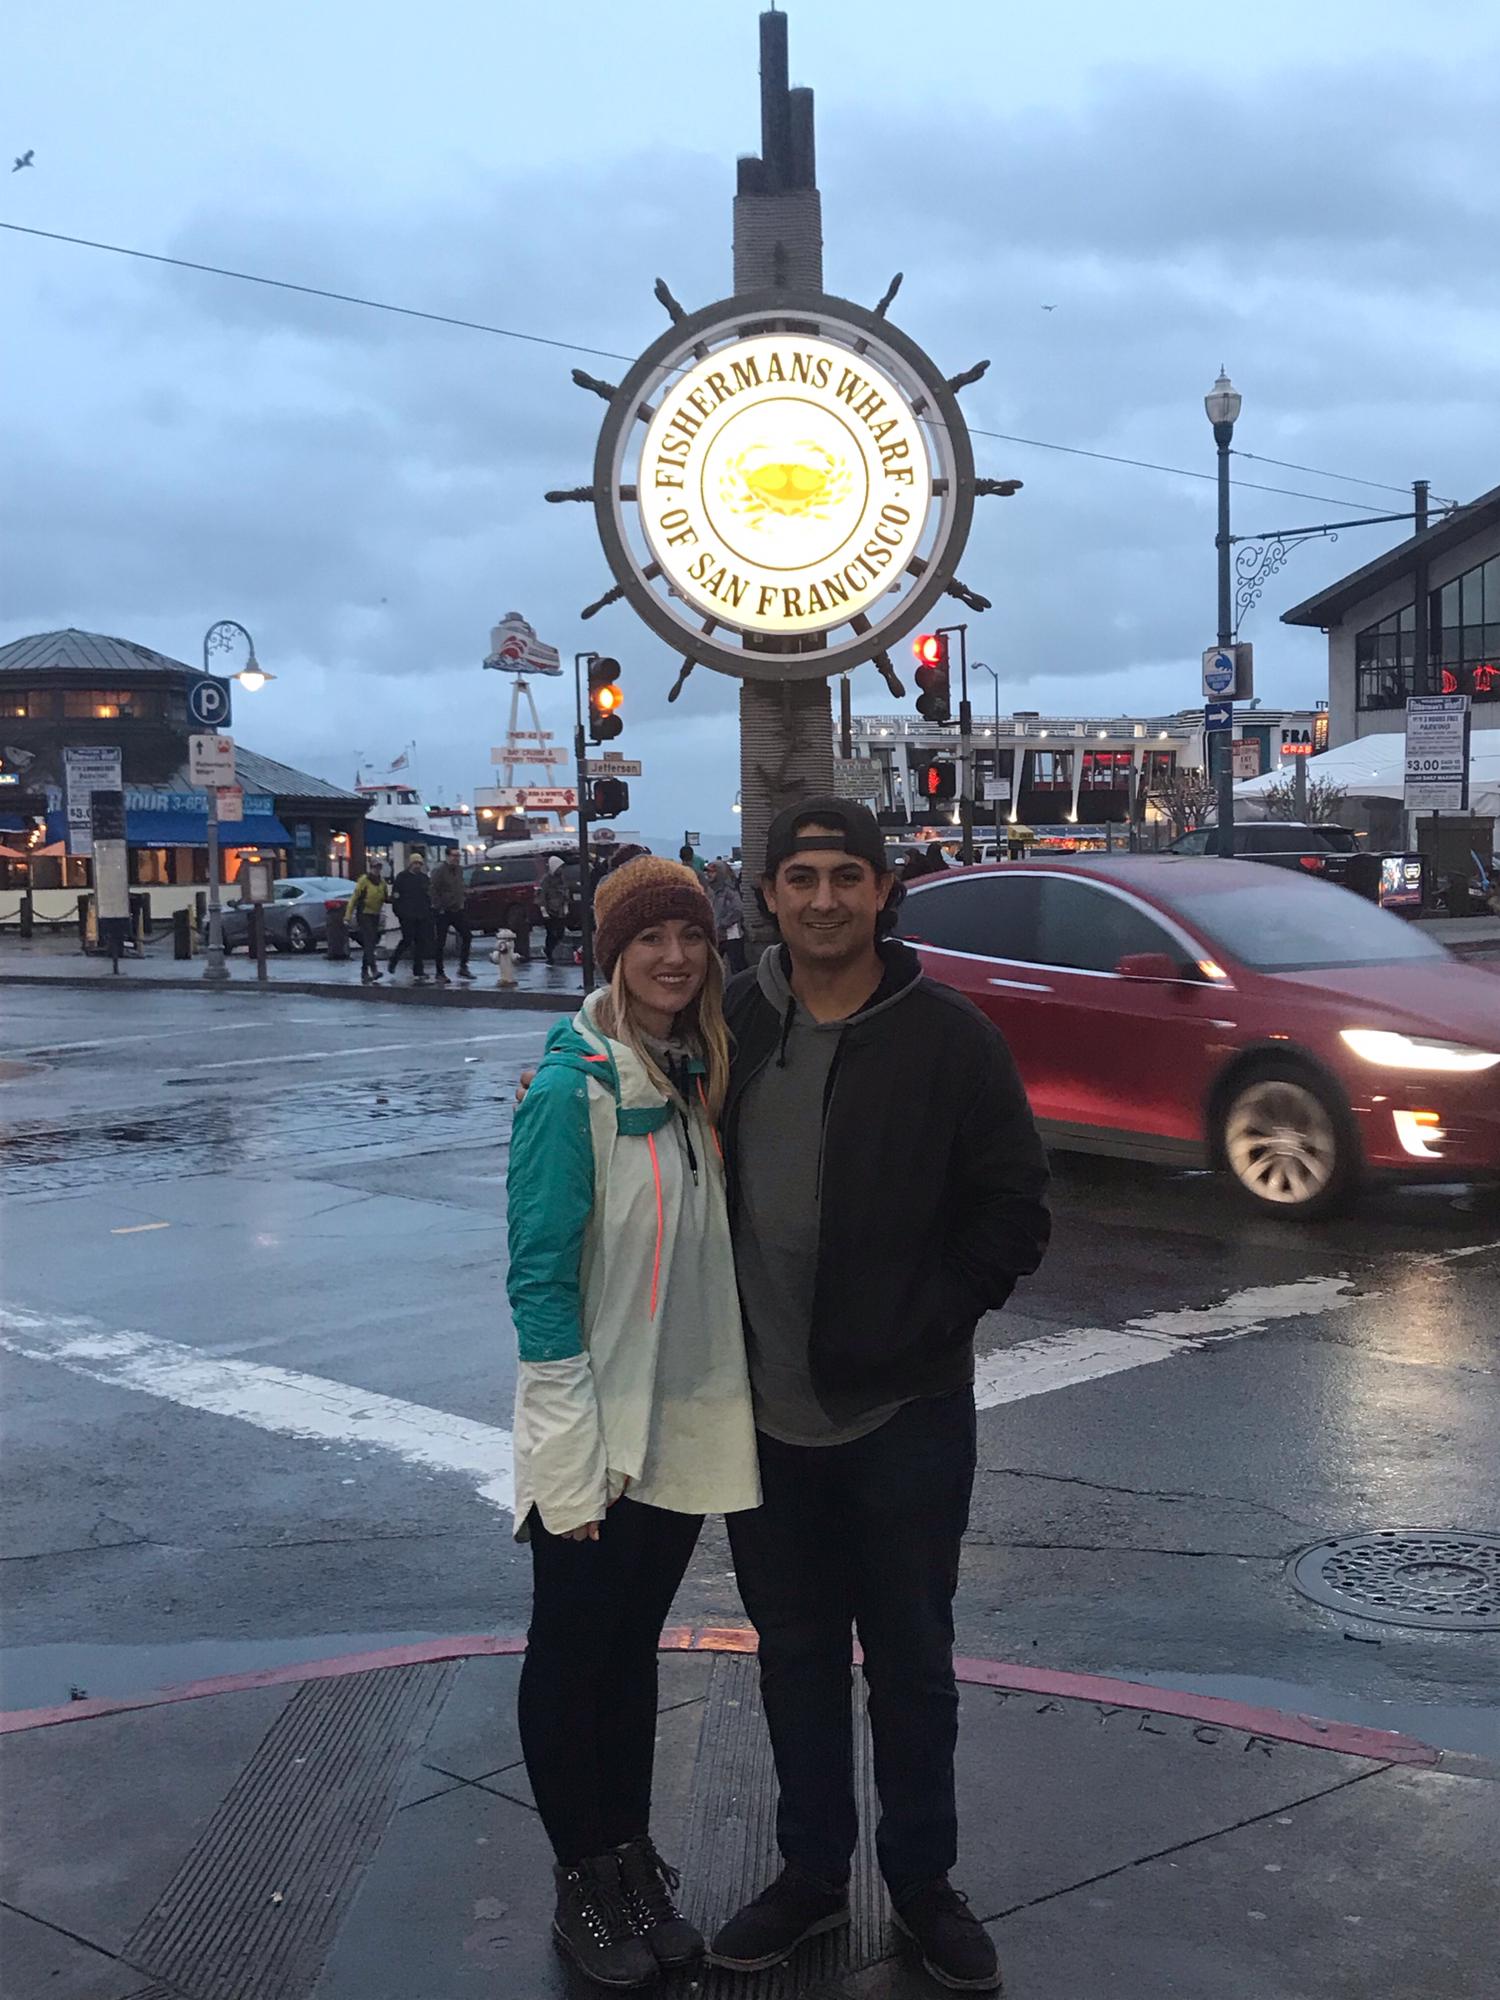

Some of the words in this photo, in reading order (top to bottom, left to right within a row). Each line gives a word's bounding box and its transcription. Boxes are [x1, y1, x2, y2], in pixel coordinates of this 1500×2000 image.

[655, 352, 833, 489] FISHERMANS
[834, 367, 914, 486] WHARF
[660, 507, 699, 547] OF
[687, 552, 750, 608] SAN
[756, 503, 911, 618] FRANCISCO
[202, 688, 220, 716] P
[1281, 745, 1312, 754] CRAB
[591, 763, 637, 773] Jefferson
[1408, 760, 1439, 771] $3.00
